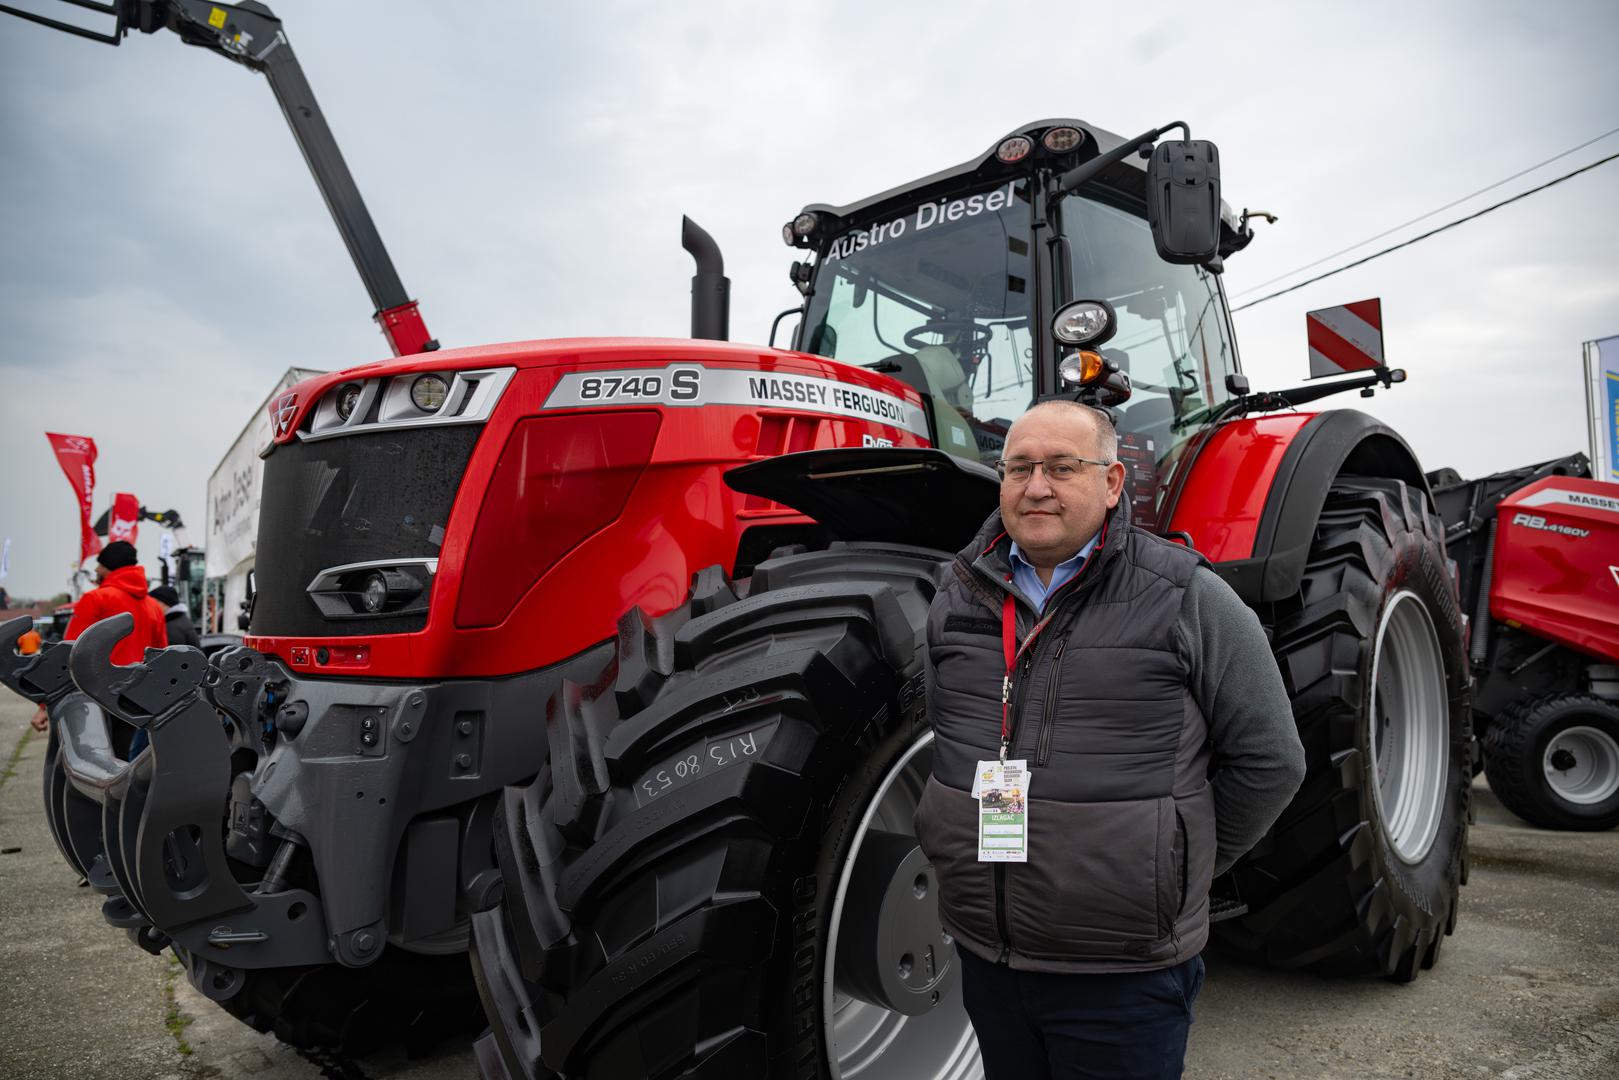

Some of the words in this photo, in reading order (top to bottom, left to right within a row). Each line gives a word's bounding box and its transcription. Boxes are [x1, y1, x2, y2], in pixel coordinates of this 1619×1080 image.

[824, 216, 907, 266] Austro
[915, 180, 1015, 231] Diesel
[580, 374, 662, 400] 8740
[669, 369, 700, 400] S
[748, 376, 827, 406] MASSEY
[833, 387, 906, 425] FERGUSON
